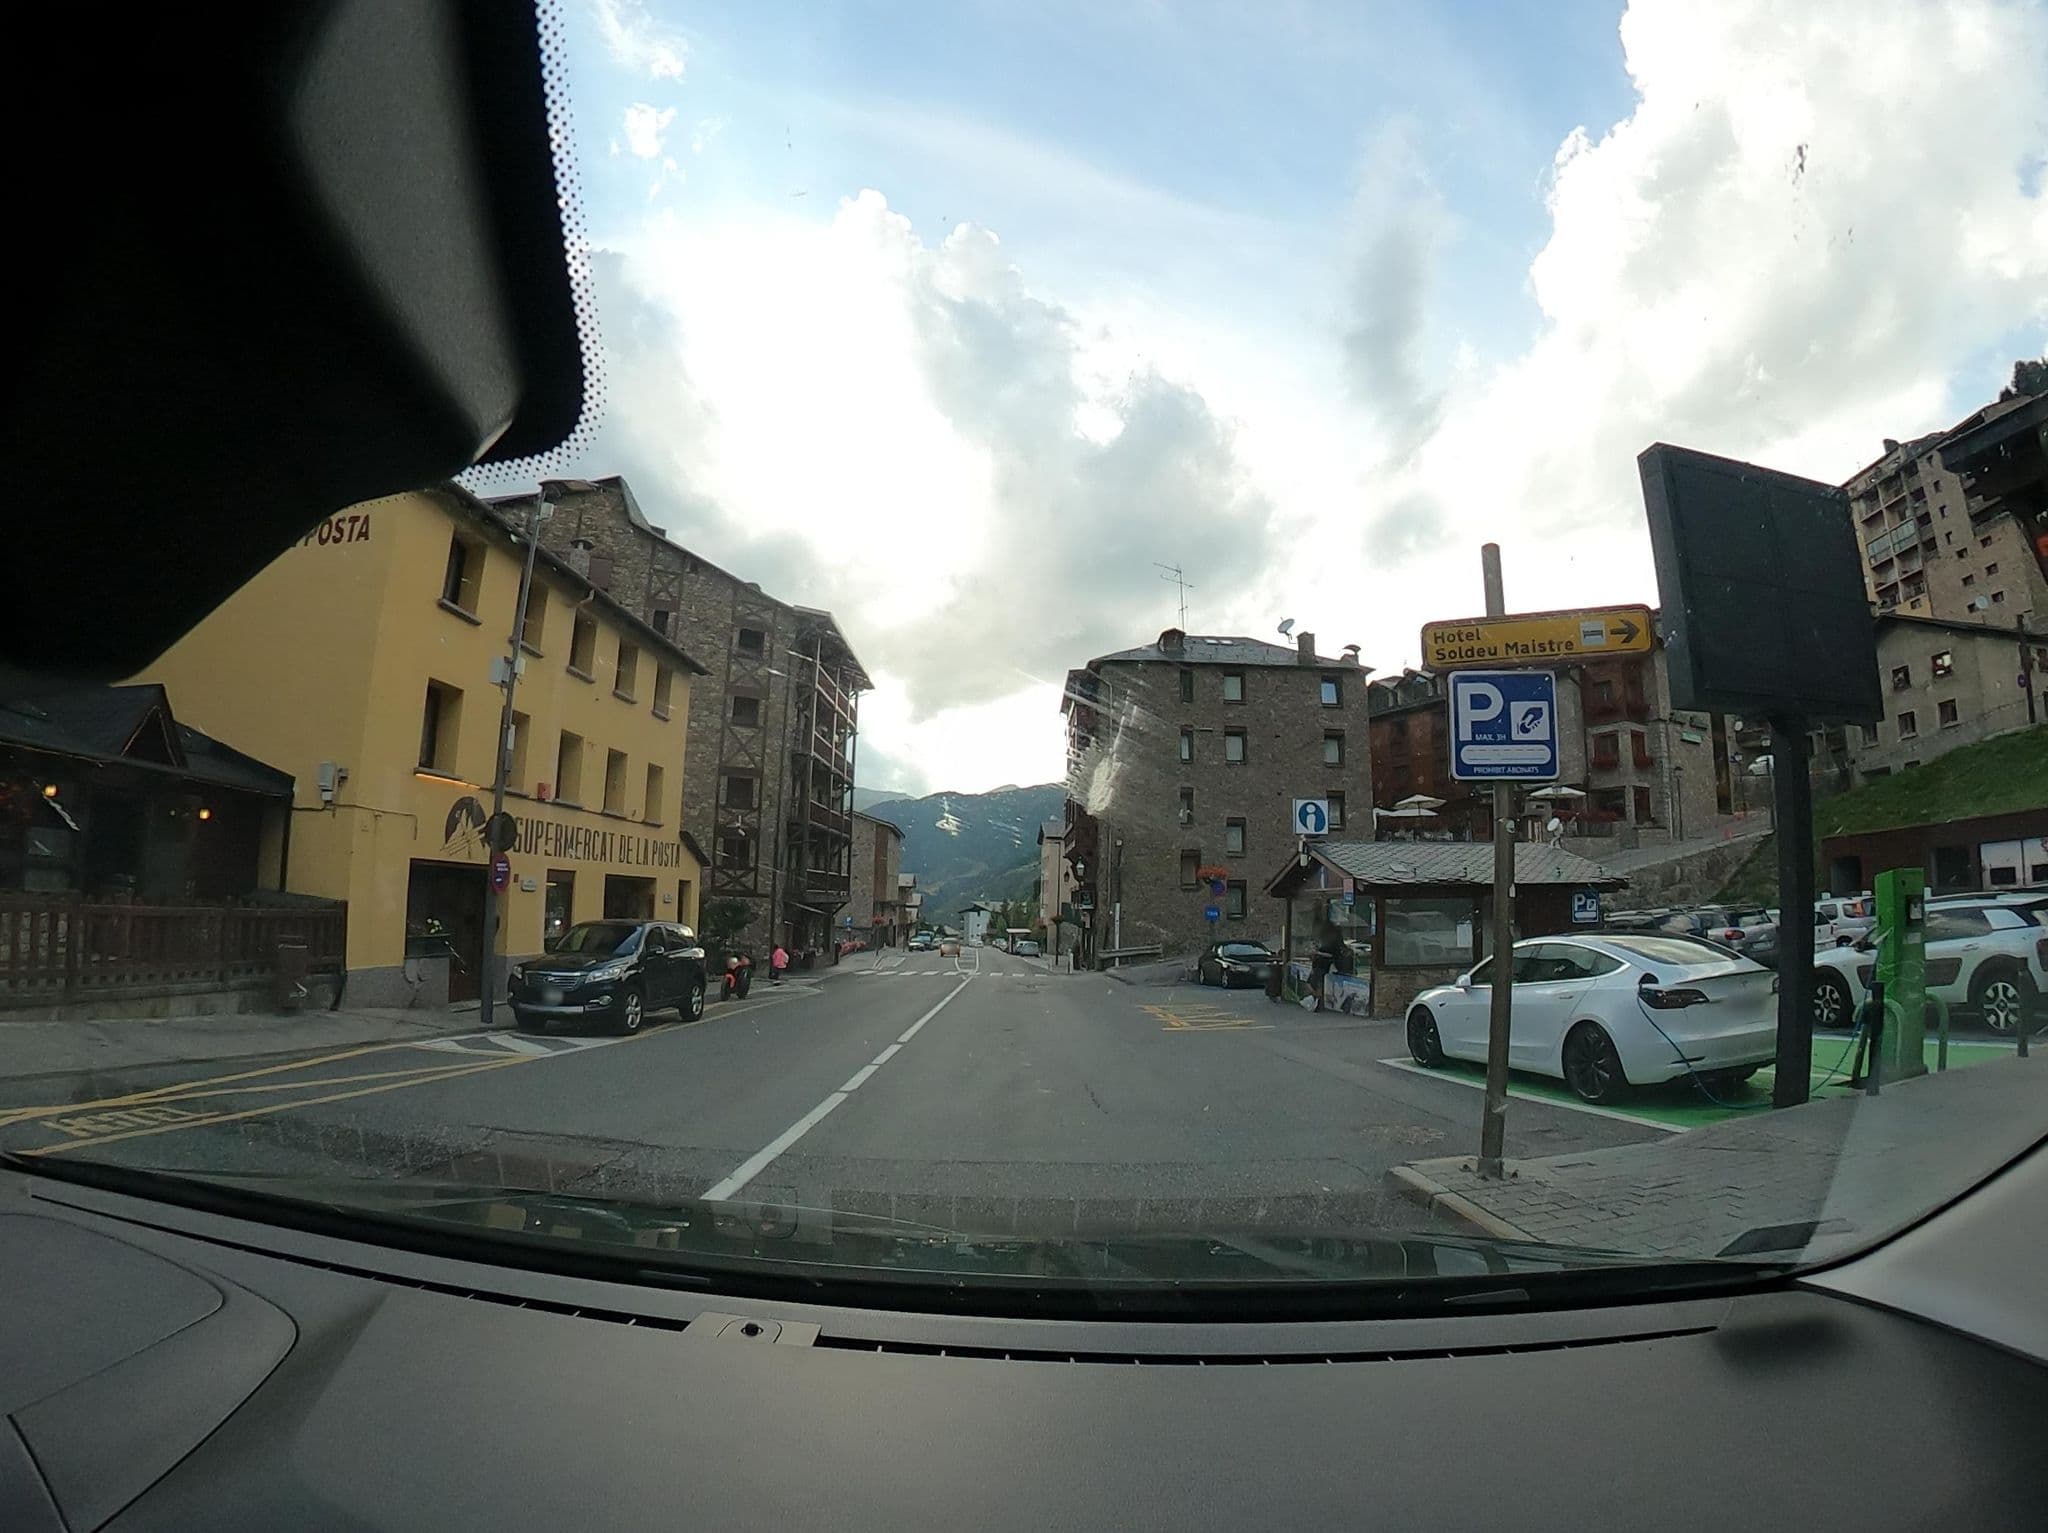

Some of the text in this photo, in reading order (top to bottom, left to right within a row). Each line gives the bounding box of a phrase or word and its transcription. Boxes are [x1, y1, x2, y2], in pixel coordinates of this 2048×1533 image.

[1433, 628, 1481, 645] Hotel
[1435, 639, 1574, 661] Soldeu Maistre
[1457, 682, 1504, 741] P
[512, 816, 681, 868] SUPERMERCAT DE LA POSTA
